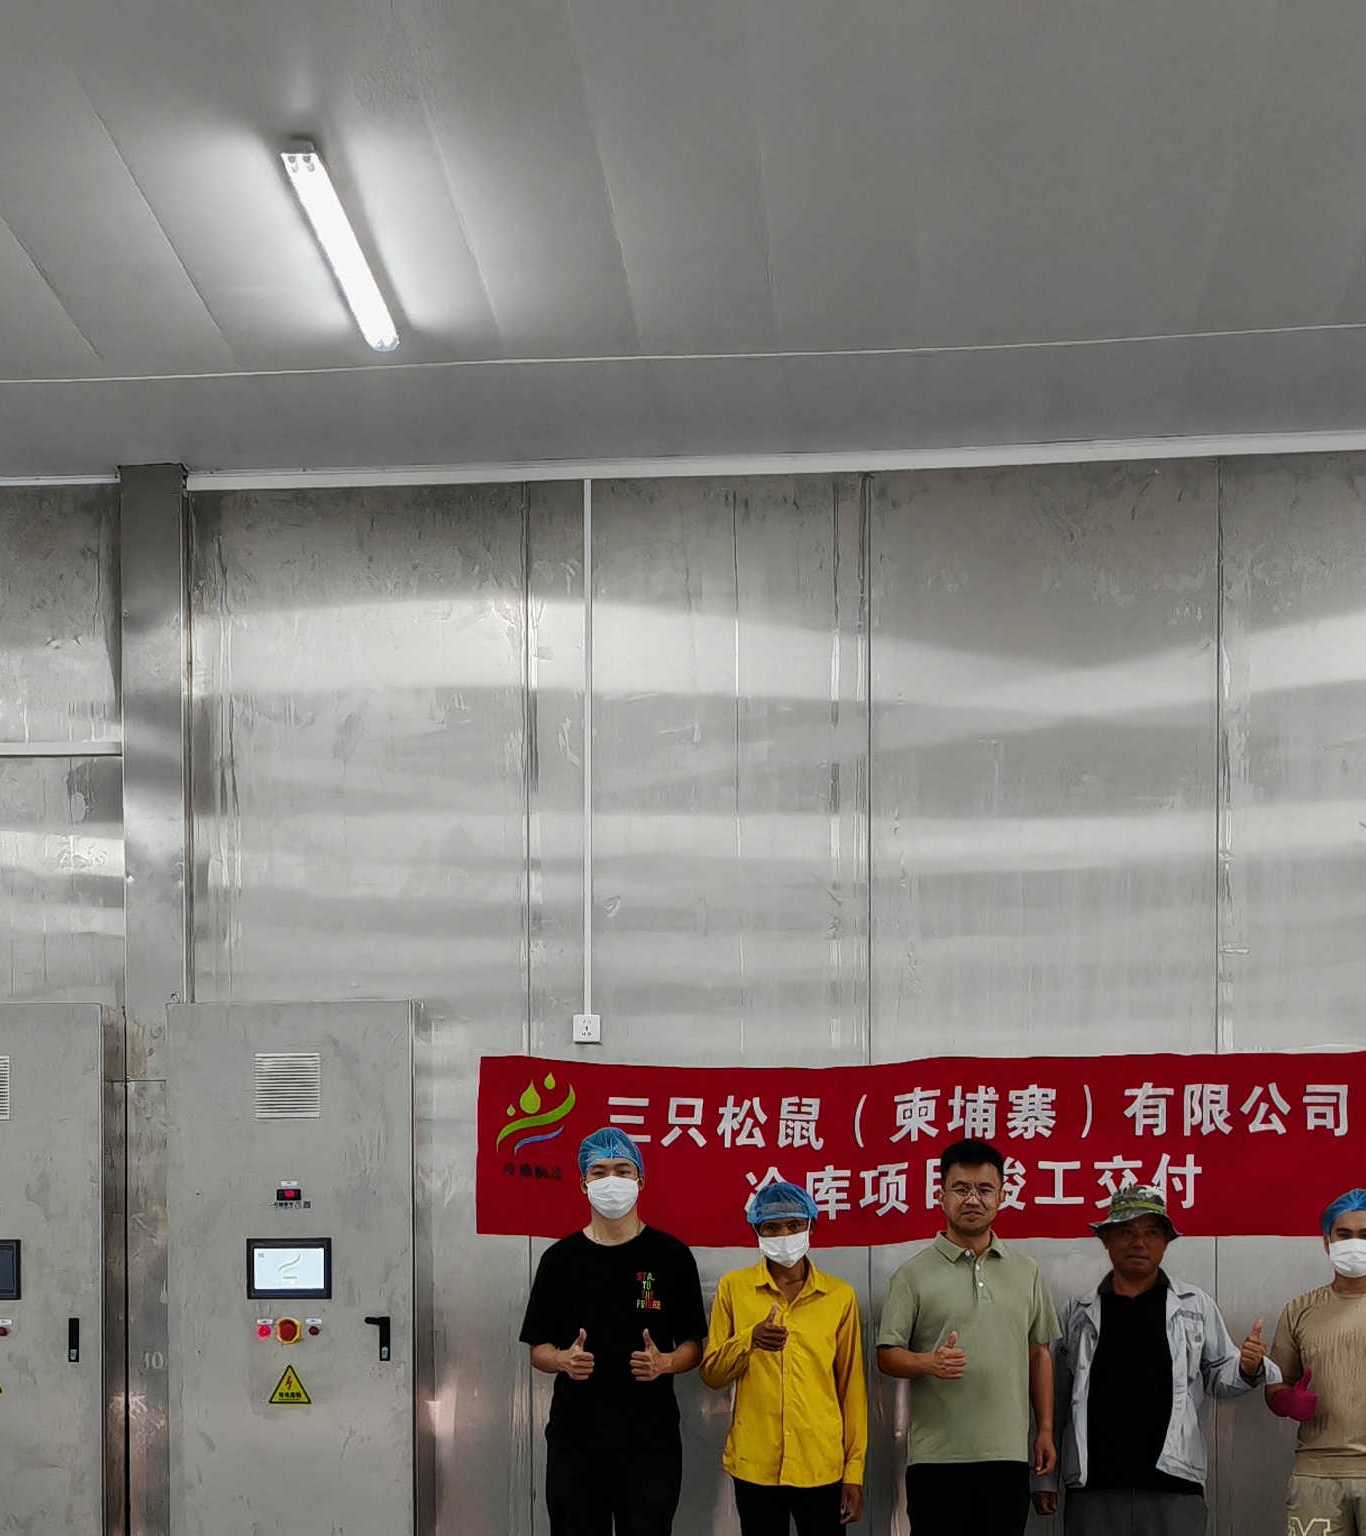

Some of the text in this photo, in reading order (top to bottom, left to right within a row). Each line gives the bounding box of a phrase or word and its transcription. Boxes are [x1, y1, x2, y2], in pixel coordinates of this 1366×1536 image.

[607, 1081, 1349, 1151] 三只松鼠（柬埔寨）有限公司
